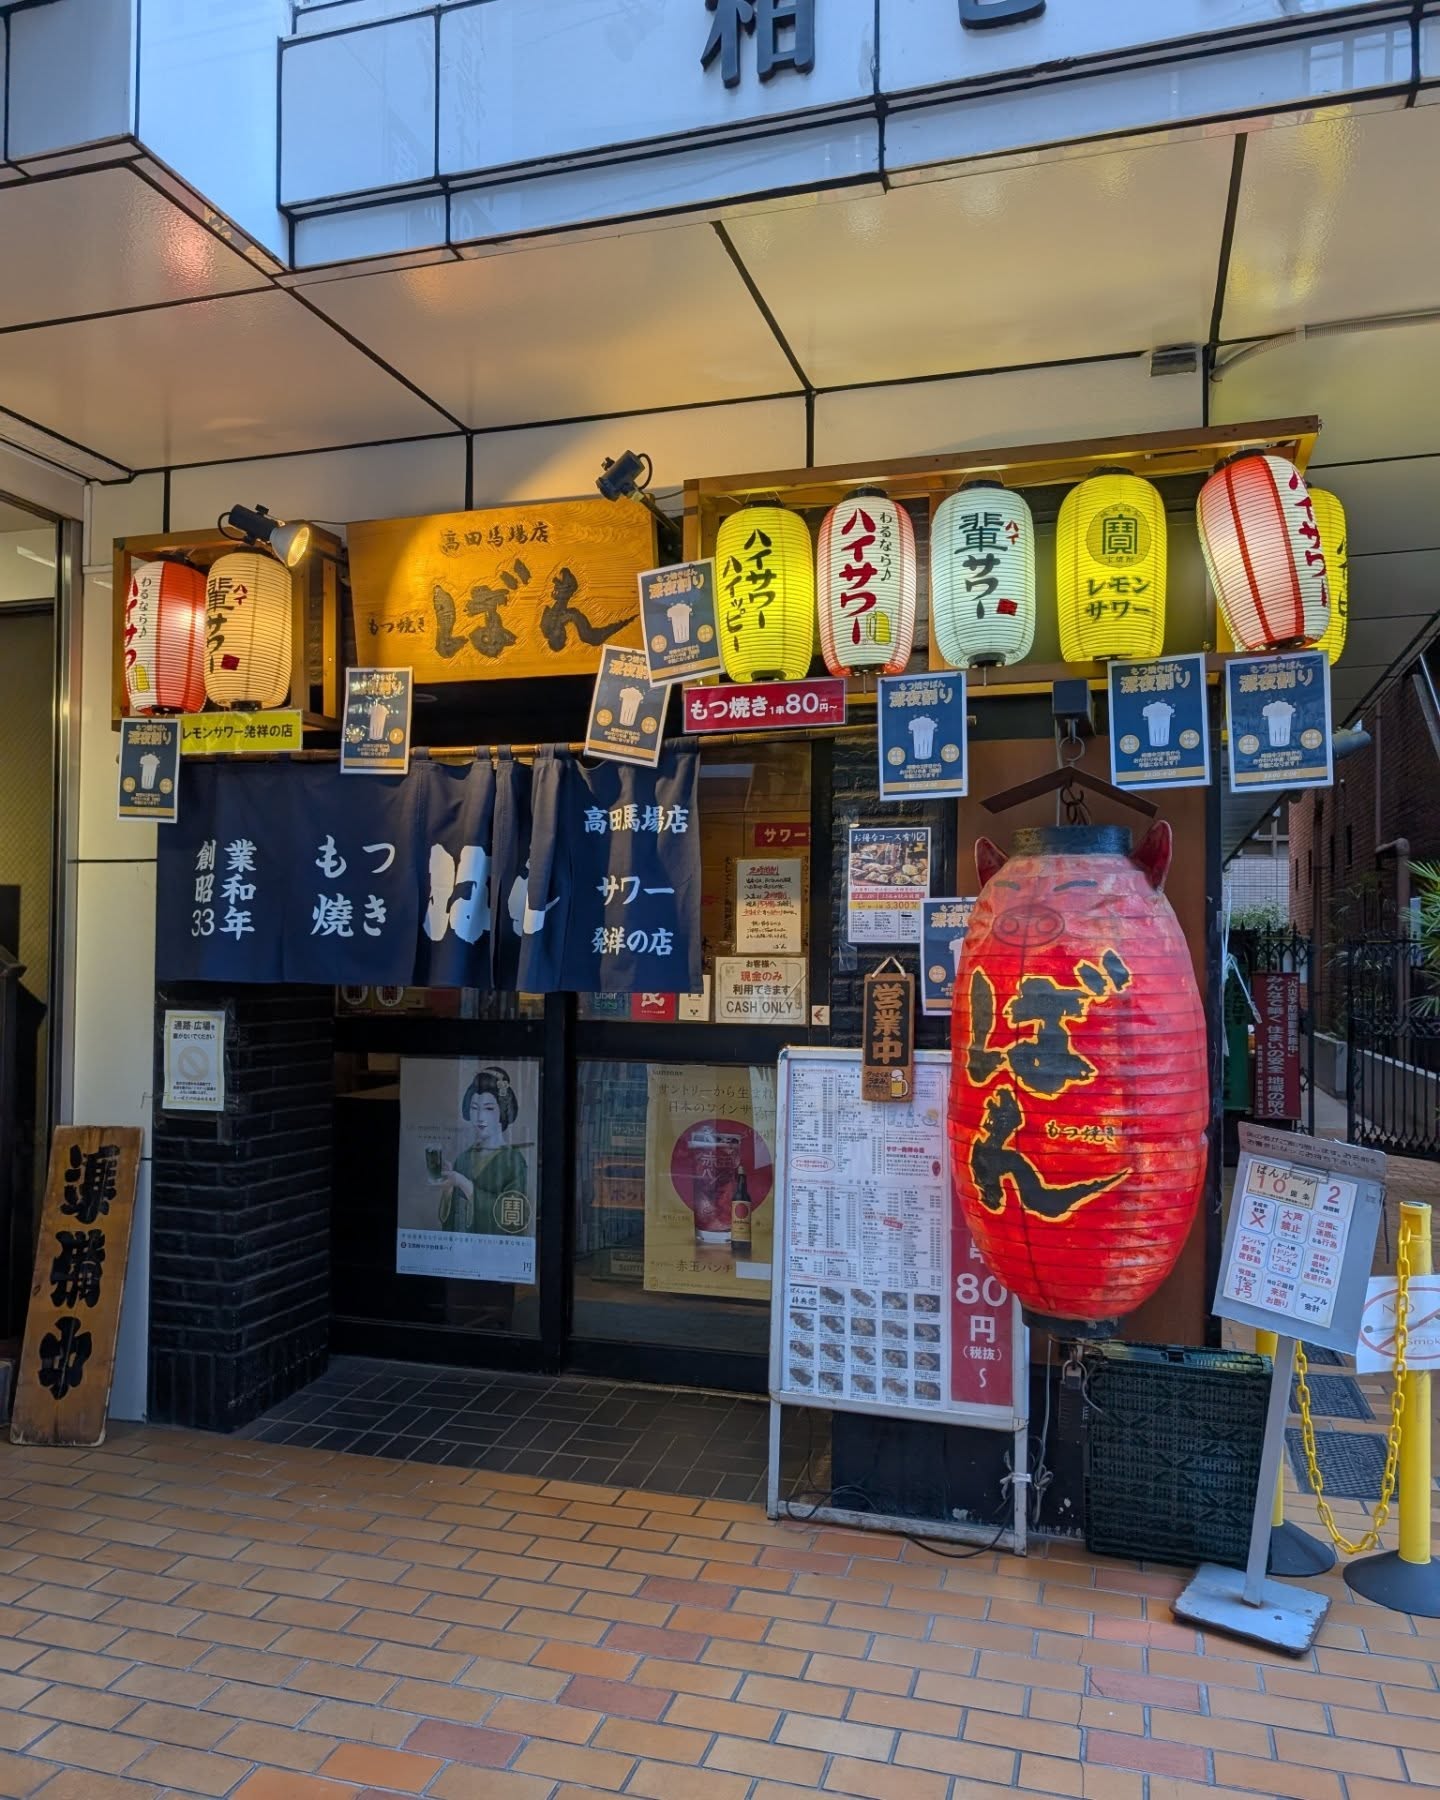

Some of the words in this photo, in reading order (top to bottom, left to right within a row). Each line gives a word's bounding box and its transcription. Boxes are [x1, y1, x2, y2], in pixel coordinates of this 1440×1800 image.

[441, 521, 551, 551] 高田馬場店
[838, 507, 877, 645] ハイサワー
[954, 512, 1008, 619] 輩サワー
[648, 573, 705, 600] 深夜割り
[743, 528, 777, 629] ハイサワー
[1086, 576, 1151, 597] レモン
[433, 558, 640, 660] ばん
[722, 555, 748, 653] ハイッピー
[1086, 600, 1152, 621] サワー
[206, 577, 234, 674] 輩サワー
[368, 615, 425, 635] もつ焼き
[1120, 671, 1191, 694] 深夜割り
[1239, 668, 1314, 693] 深夜割り
[889, 687, 953, 708] 深夜割り
[183, 722, 293, 740] レモンサワー発祥の店
[583, 803, 689, 835] 高田馬場店
[315, 834, 396, 879] もつ
[596, 875, 675, 906] サワー
[745, 959, 777, 968] お客様へ
[740, 970, 782, 982] 現金のみ
[732, 984, 792, 996] 利用できます
[726, 1001, 758, 1015] CASH
[762, 1001, 794, 1015] ONLY
[872, 982, 906, 1064] 営業中
[966, 948, 1134, 1222] ばん
[1046, 1120, 1115, 1142] もつ焼き
[1327, 1185, 1341, 1204] 2
[1280, 1221, 1302, 1234] 禁止
[1282, 1210, 1304, 1222] 大声
[956, 1272, 1008, 1307] 80
[1300, 1292, 1328, 1306] テーブル
[1304, 1303, 1321, 1313] 会計
[969, 1315, 996, 1343] 円
